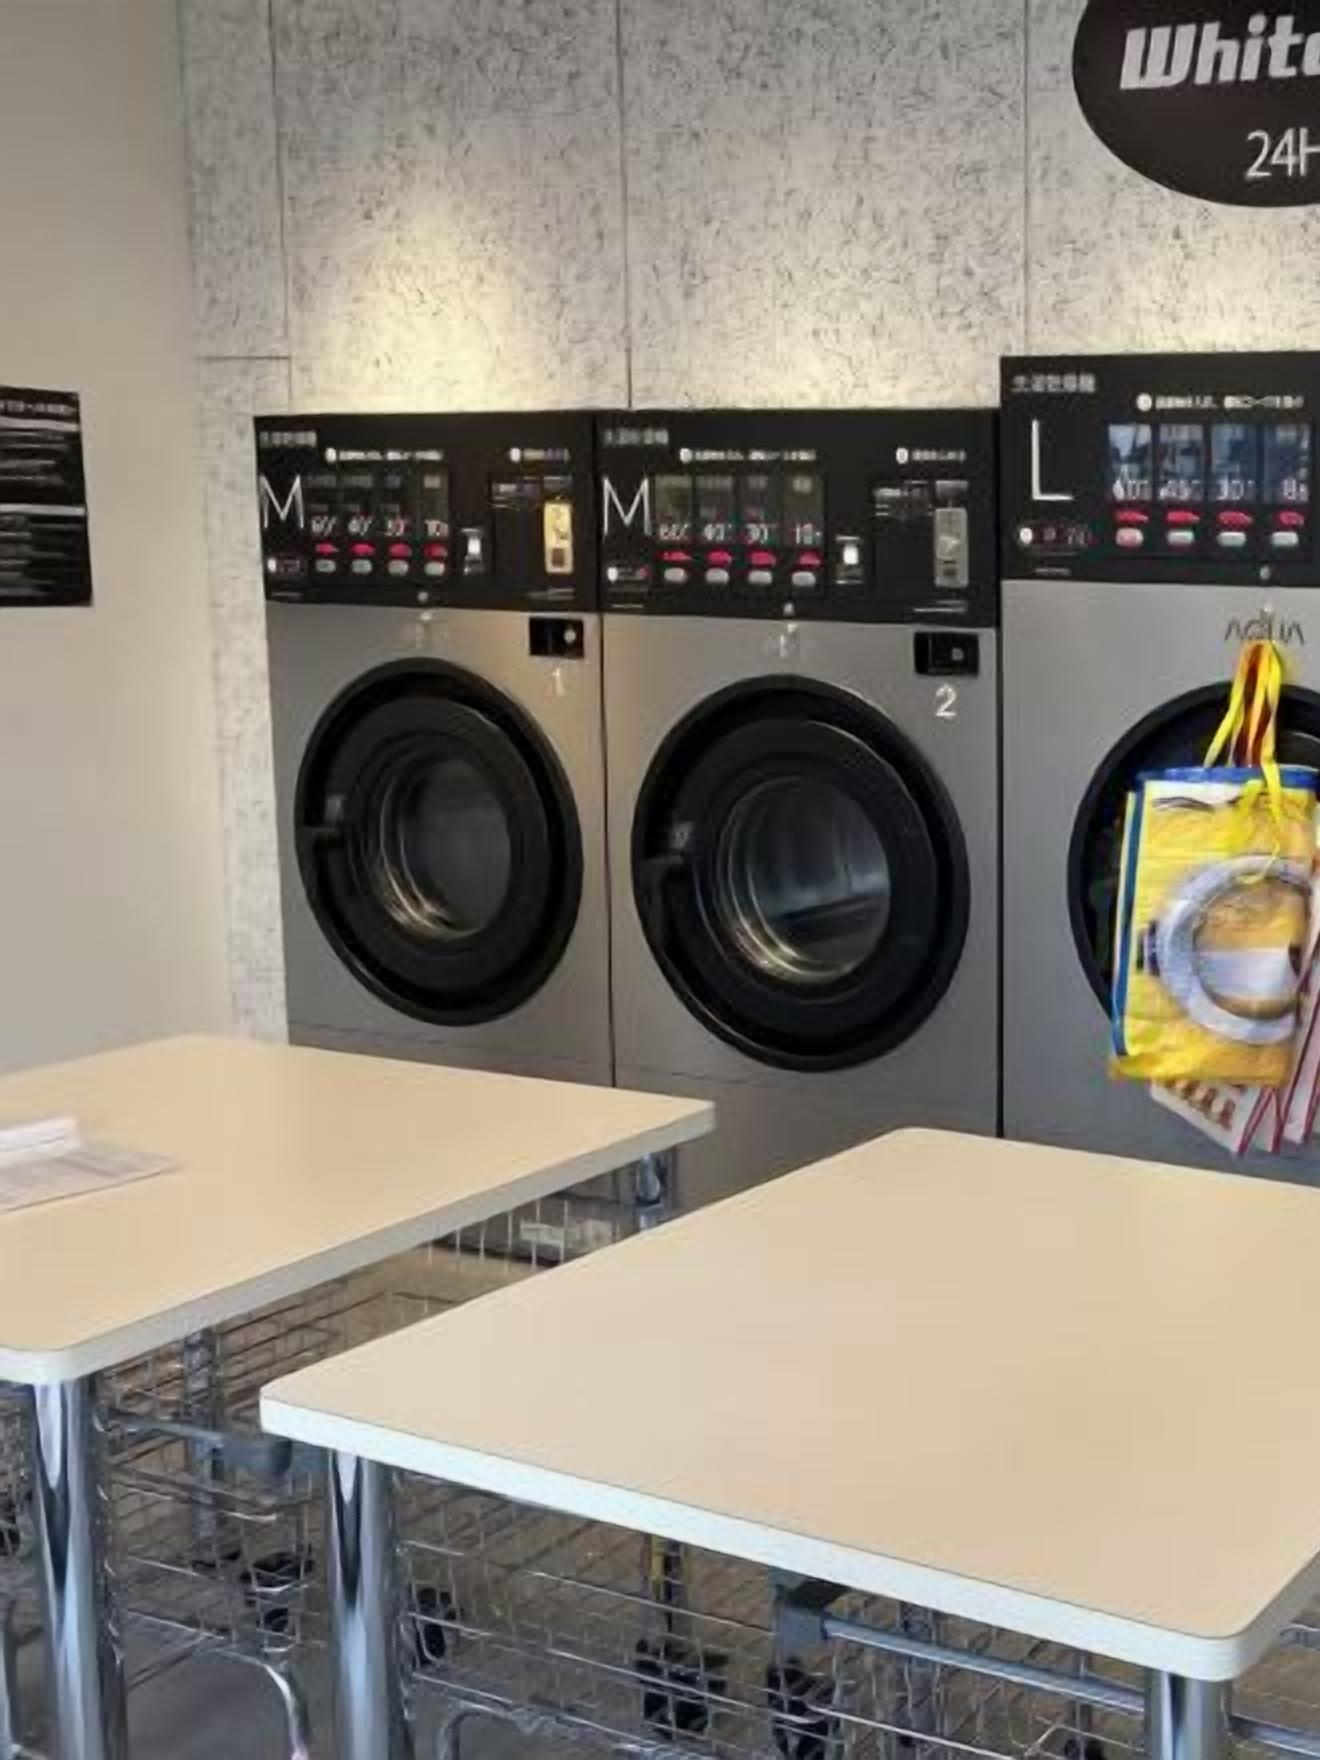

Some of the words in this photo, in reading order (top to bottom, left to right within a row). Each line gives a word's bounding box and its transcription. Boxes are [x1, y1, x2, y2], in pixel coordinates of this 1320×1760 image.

[1031, 419, 1074, 501] L
[259, 474, 304, 530] M
[603, 476, 651, 538] M
[934, 684, 957, 718] 2
